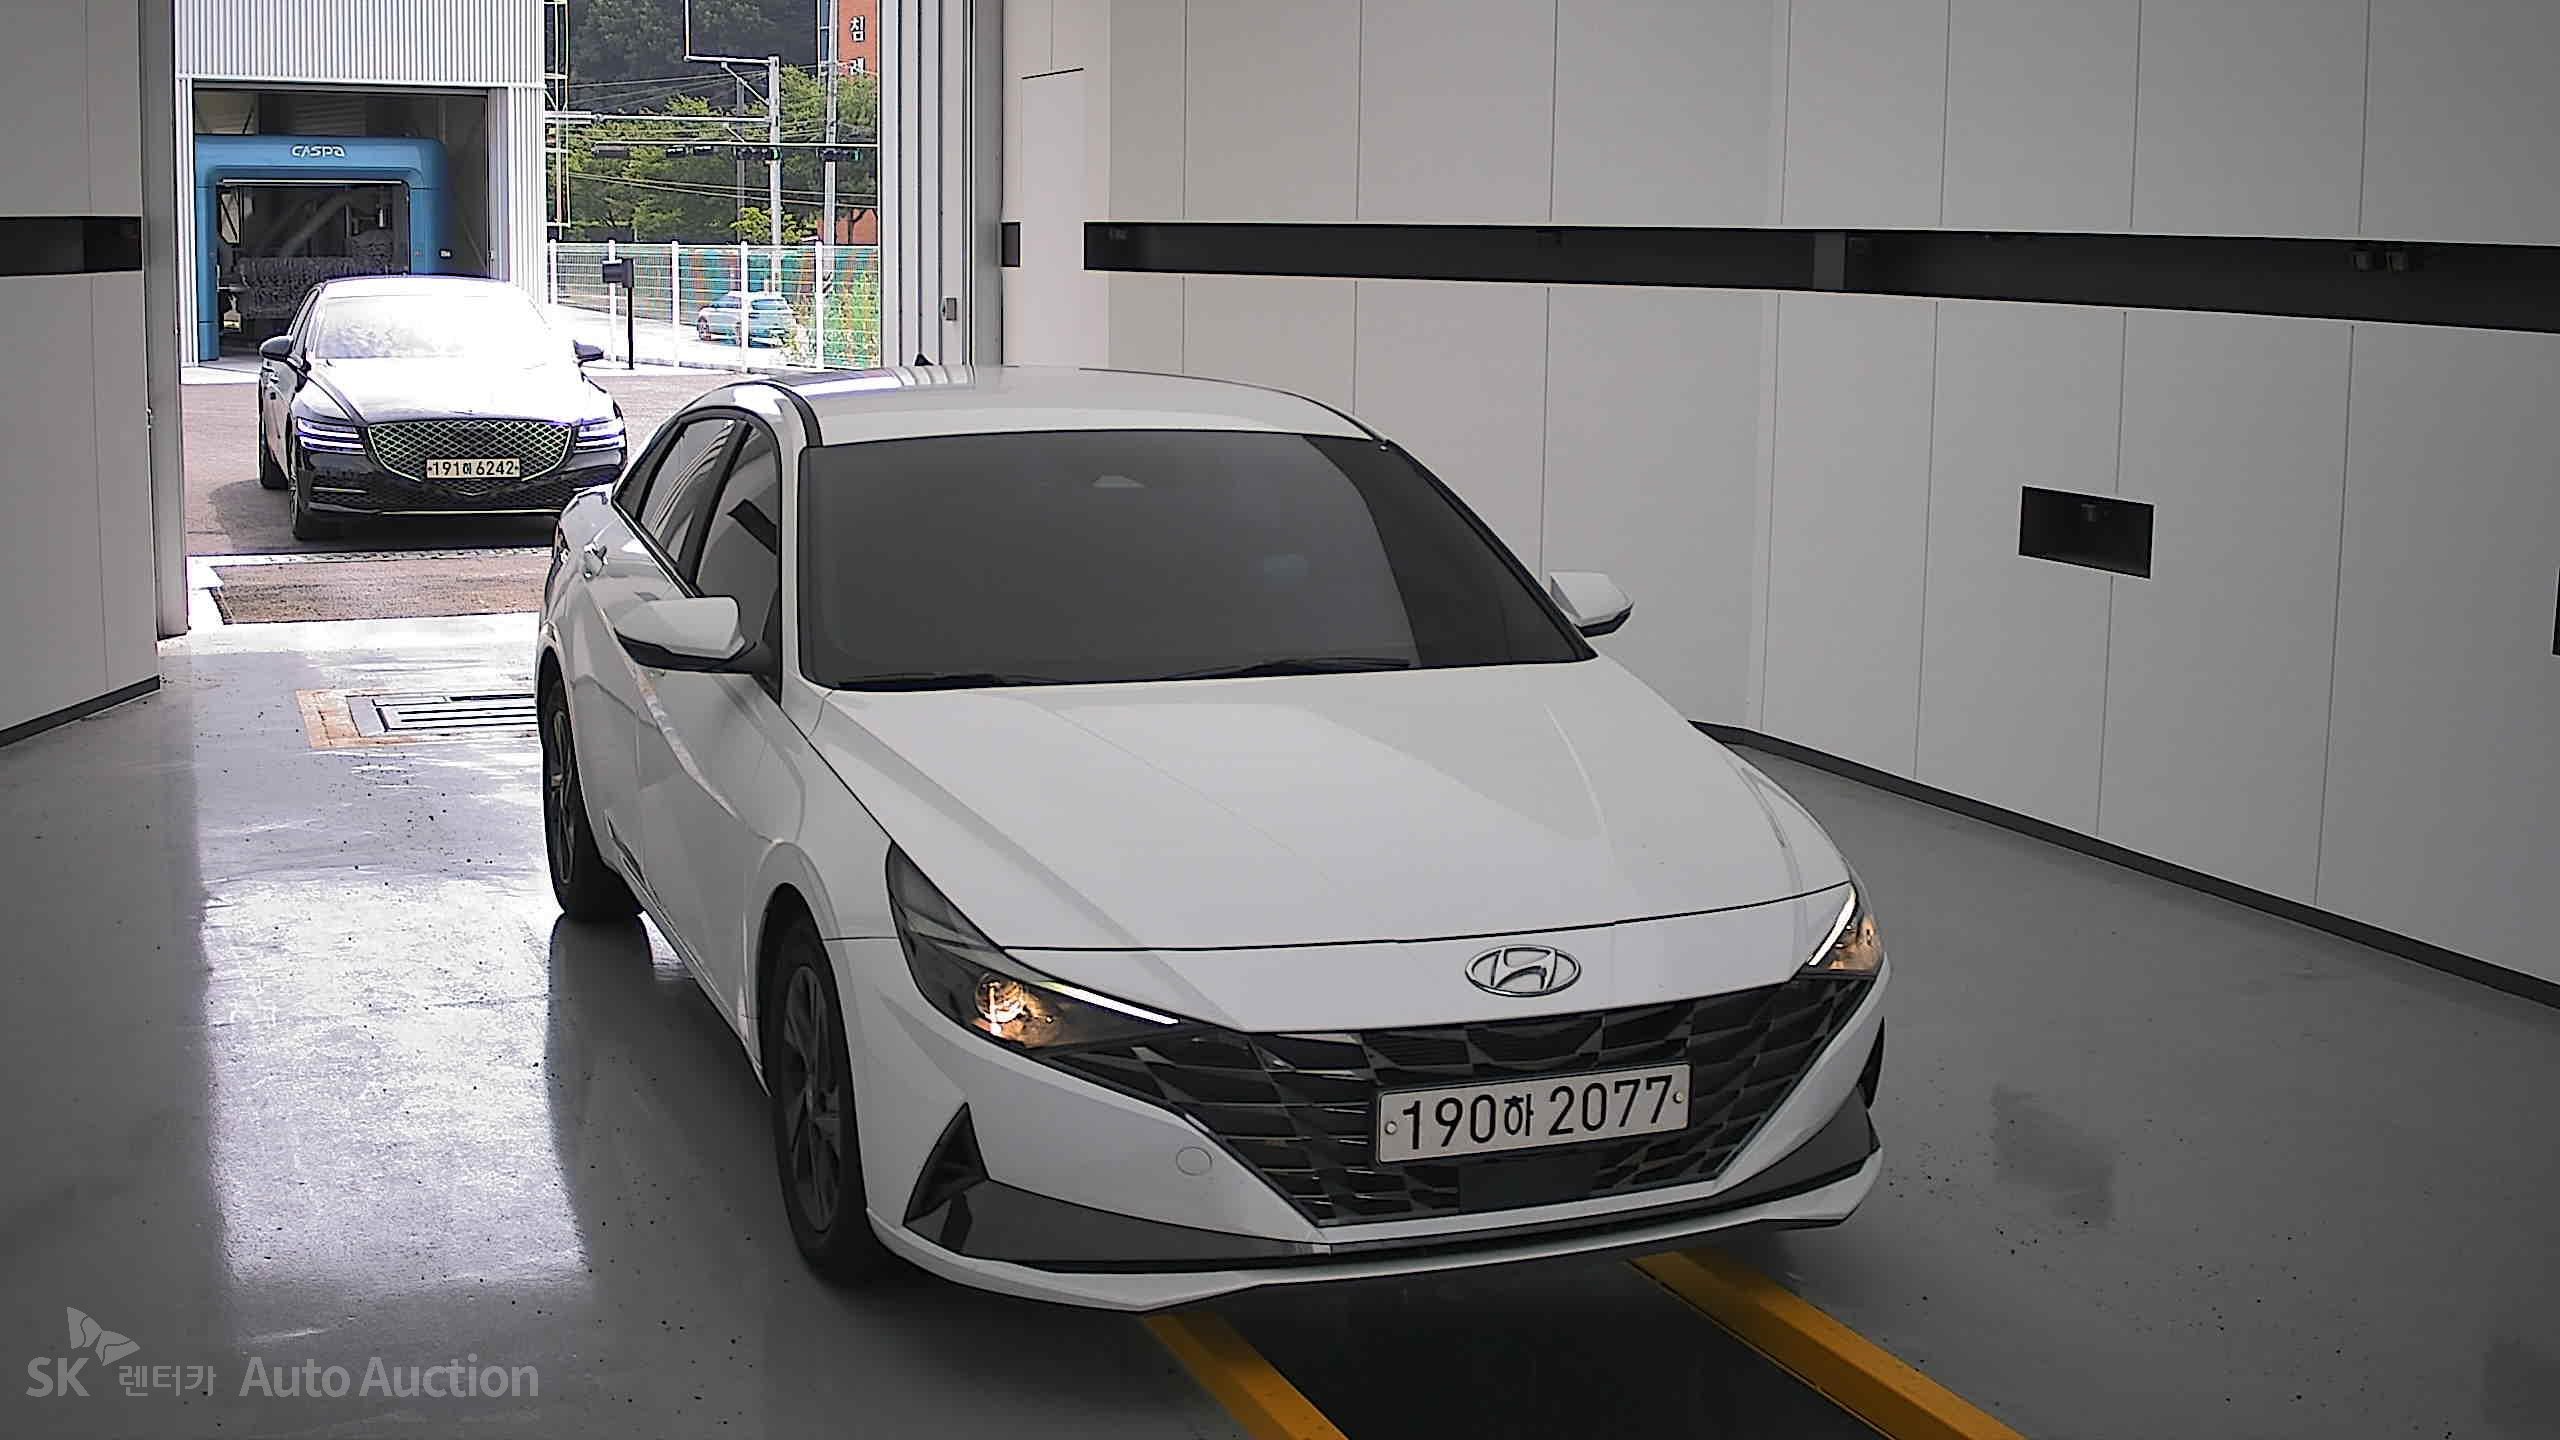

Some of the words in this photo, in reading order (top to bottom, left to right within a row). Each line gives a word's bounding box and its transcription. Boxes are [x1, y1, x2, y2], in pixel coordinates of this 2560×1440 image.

[476, 460, 515, 476] 6242
[1402, 1093, 1535, 1151] 190하
[1548, 1074, 1673, 1136] 2077
